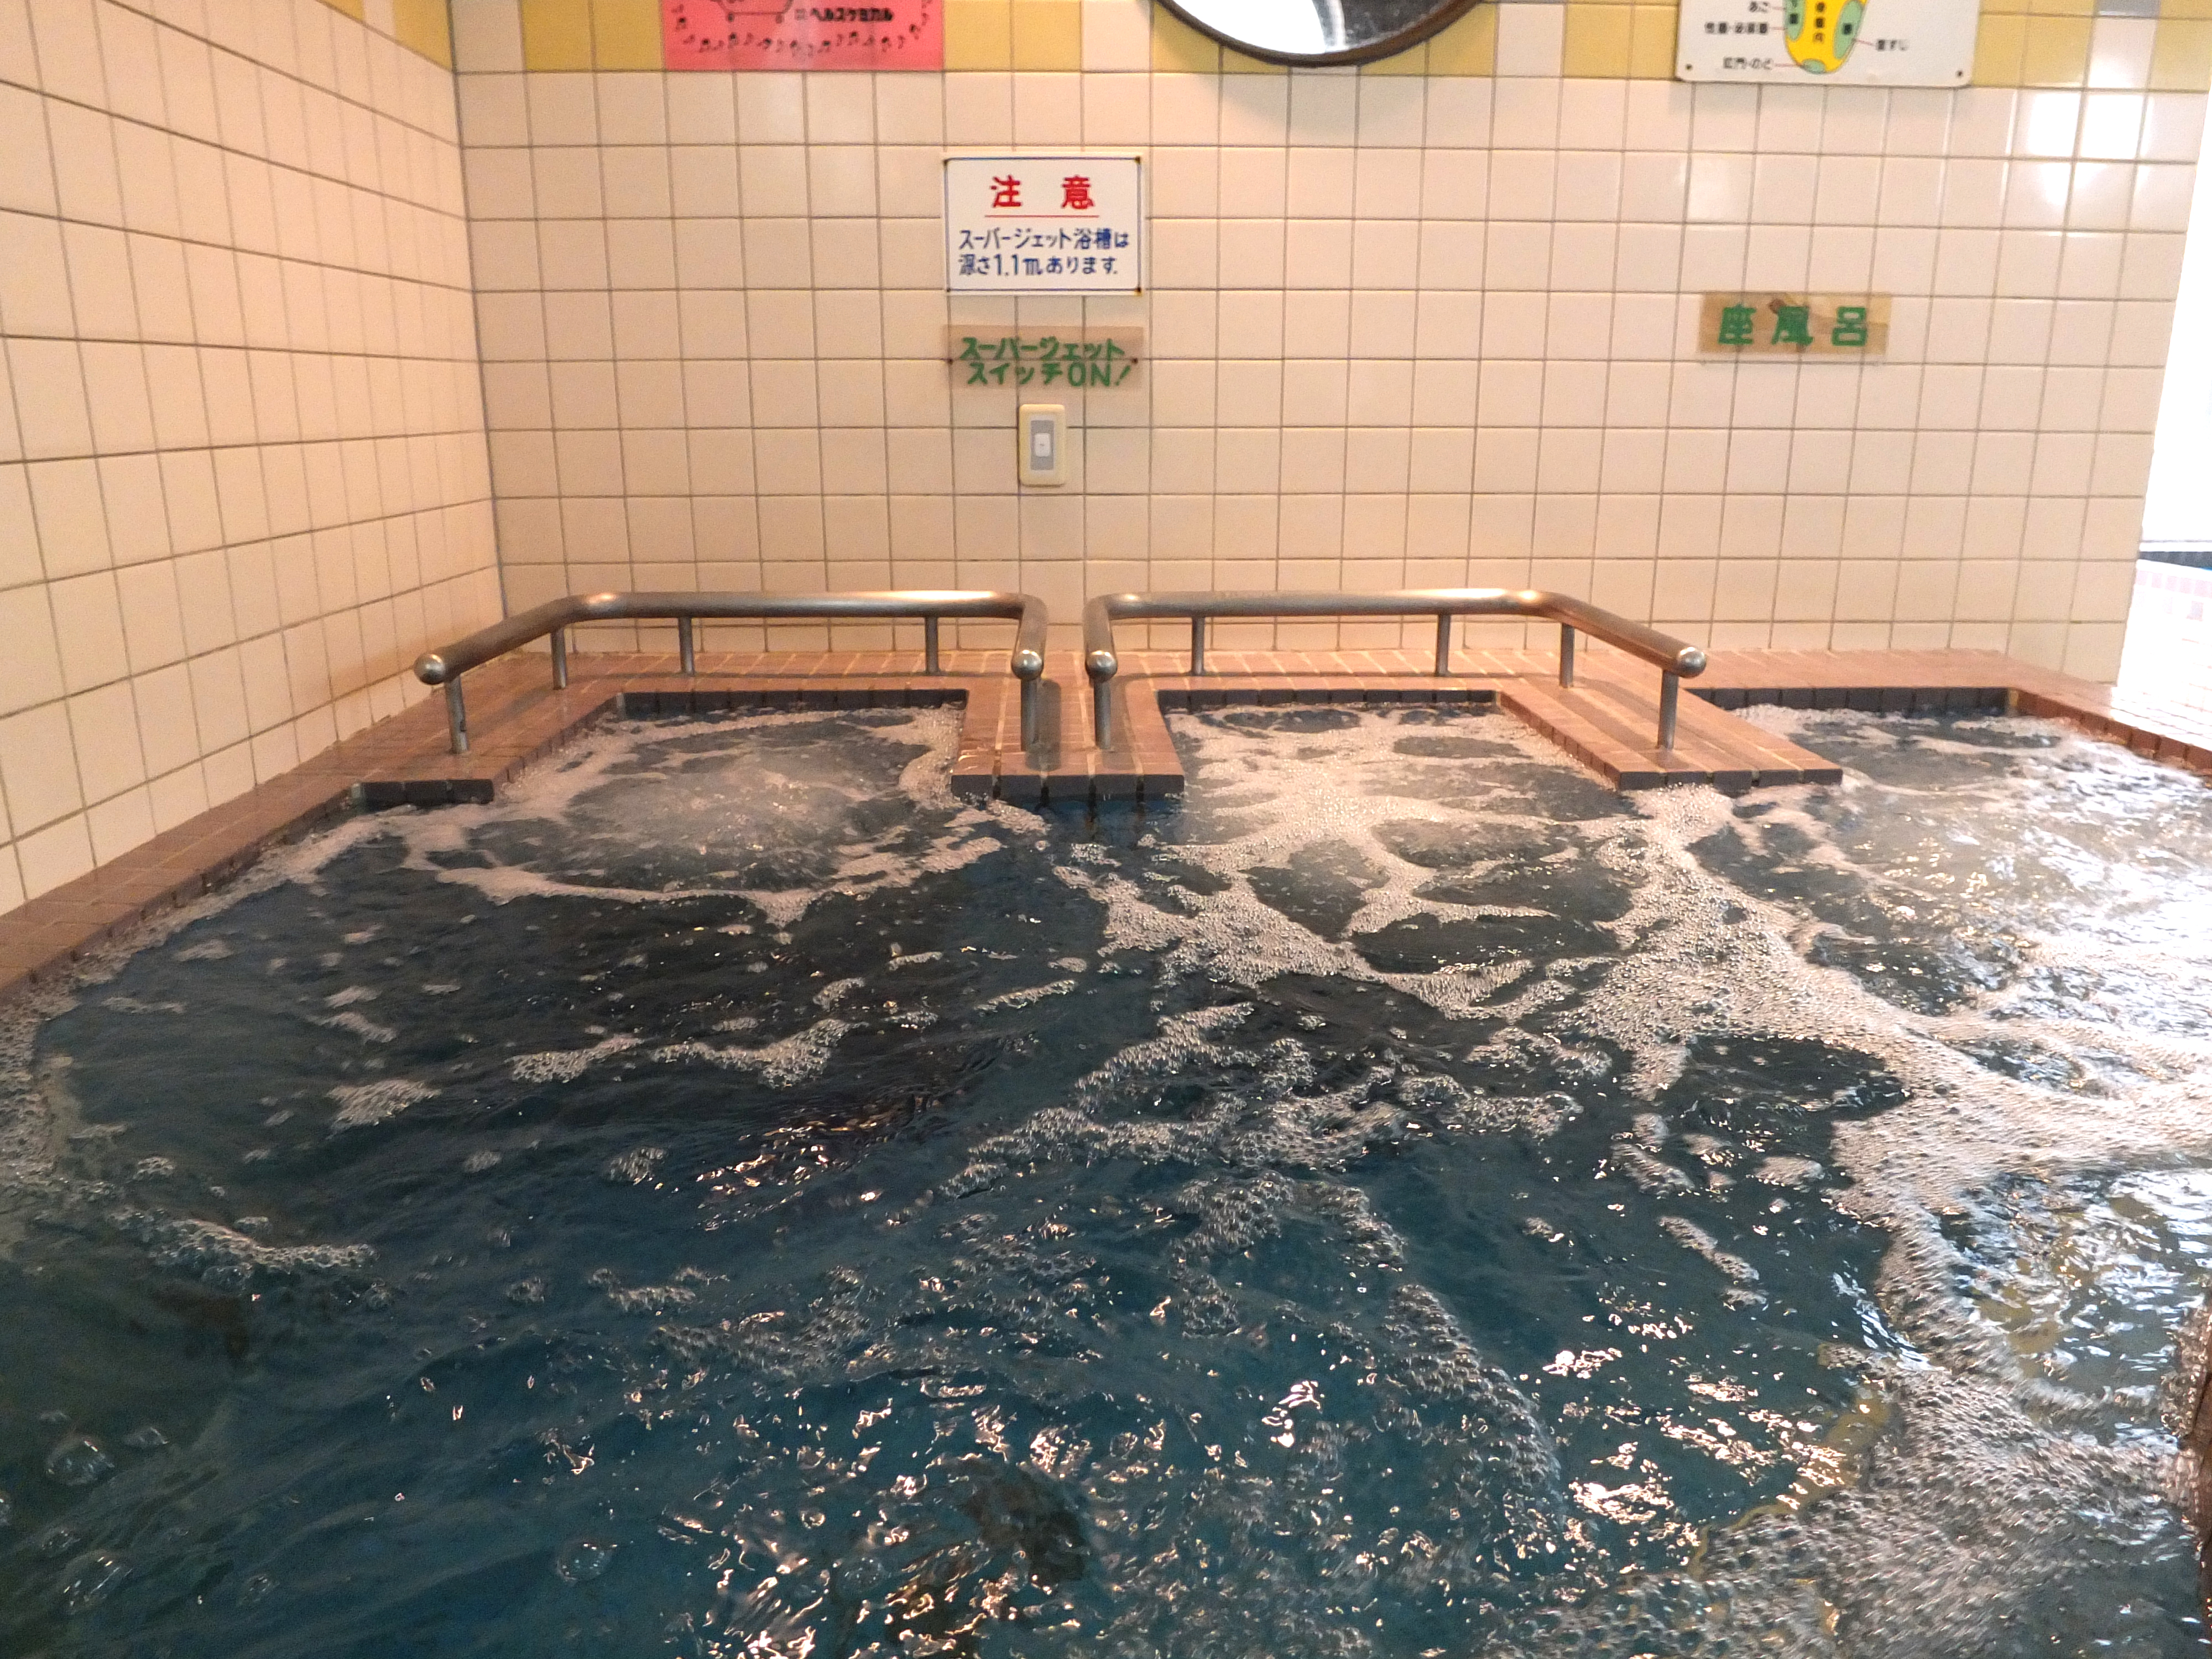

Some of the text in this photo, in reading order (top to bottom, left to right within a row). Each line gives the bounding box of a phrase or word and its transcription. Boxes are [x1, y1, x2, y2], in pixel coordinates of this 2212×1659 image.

[989, 174, 1094, 210] 注意
[958, 227, 1130, 250] スーパージェット浴槽は
[1718, 302, 1869, 347] 座風呂
